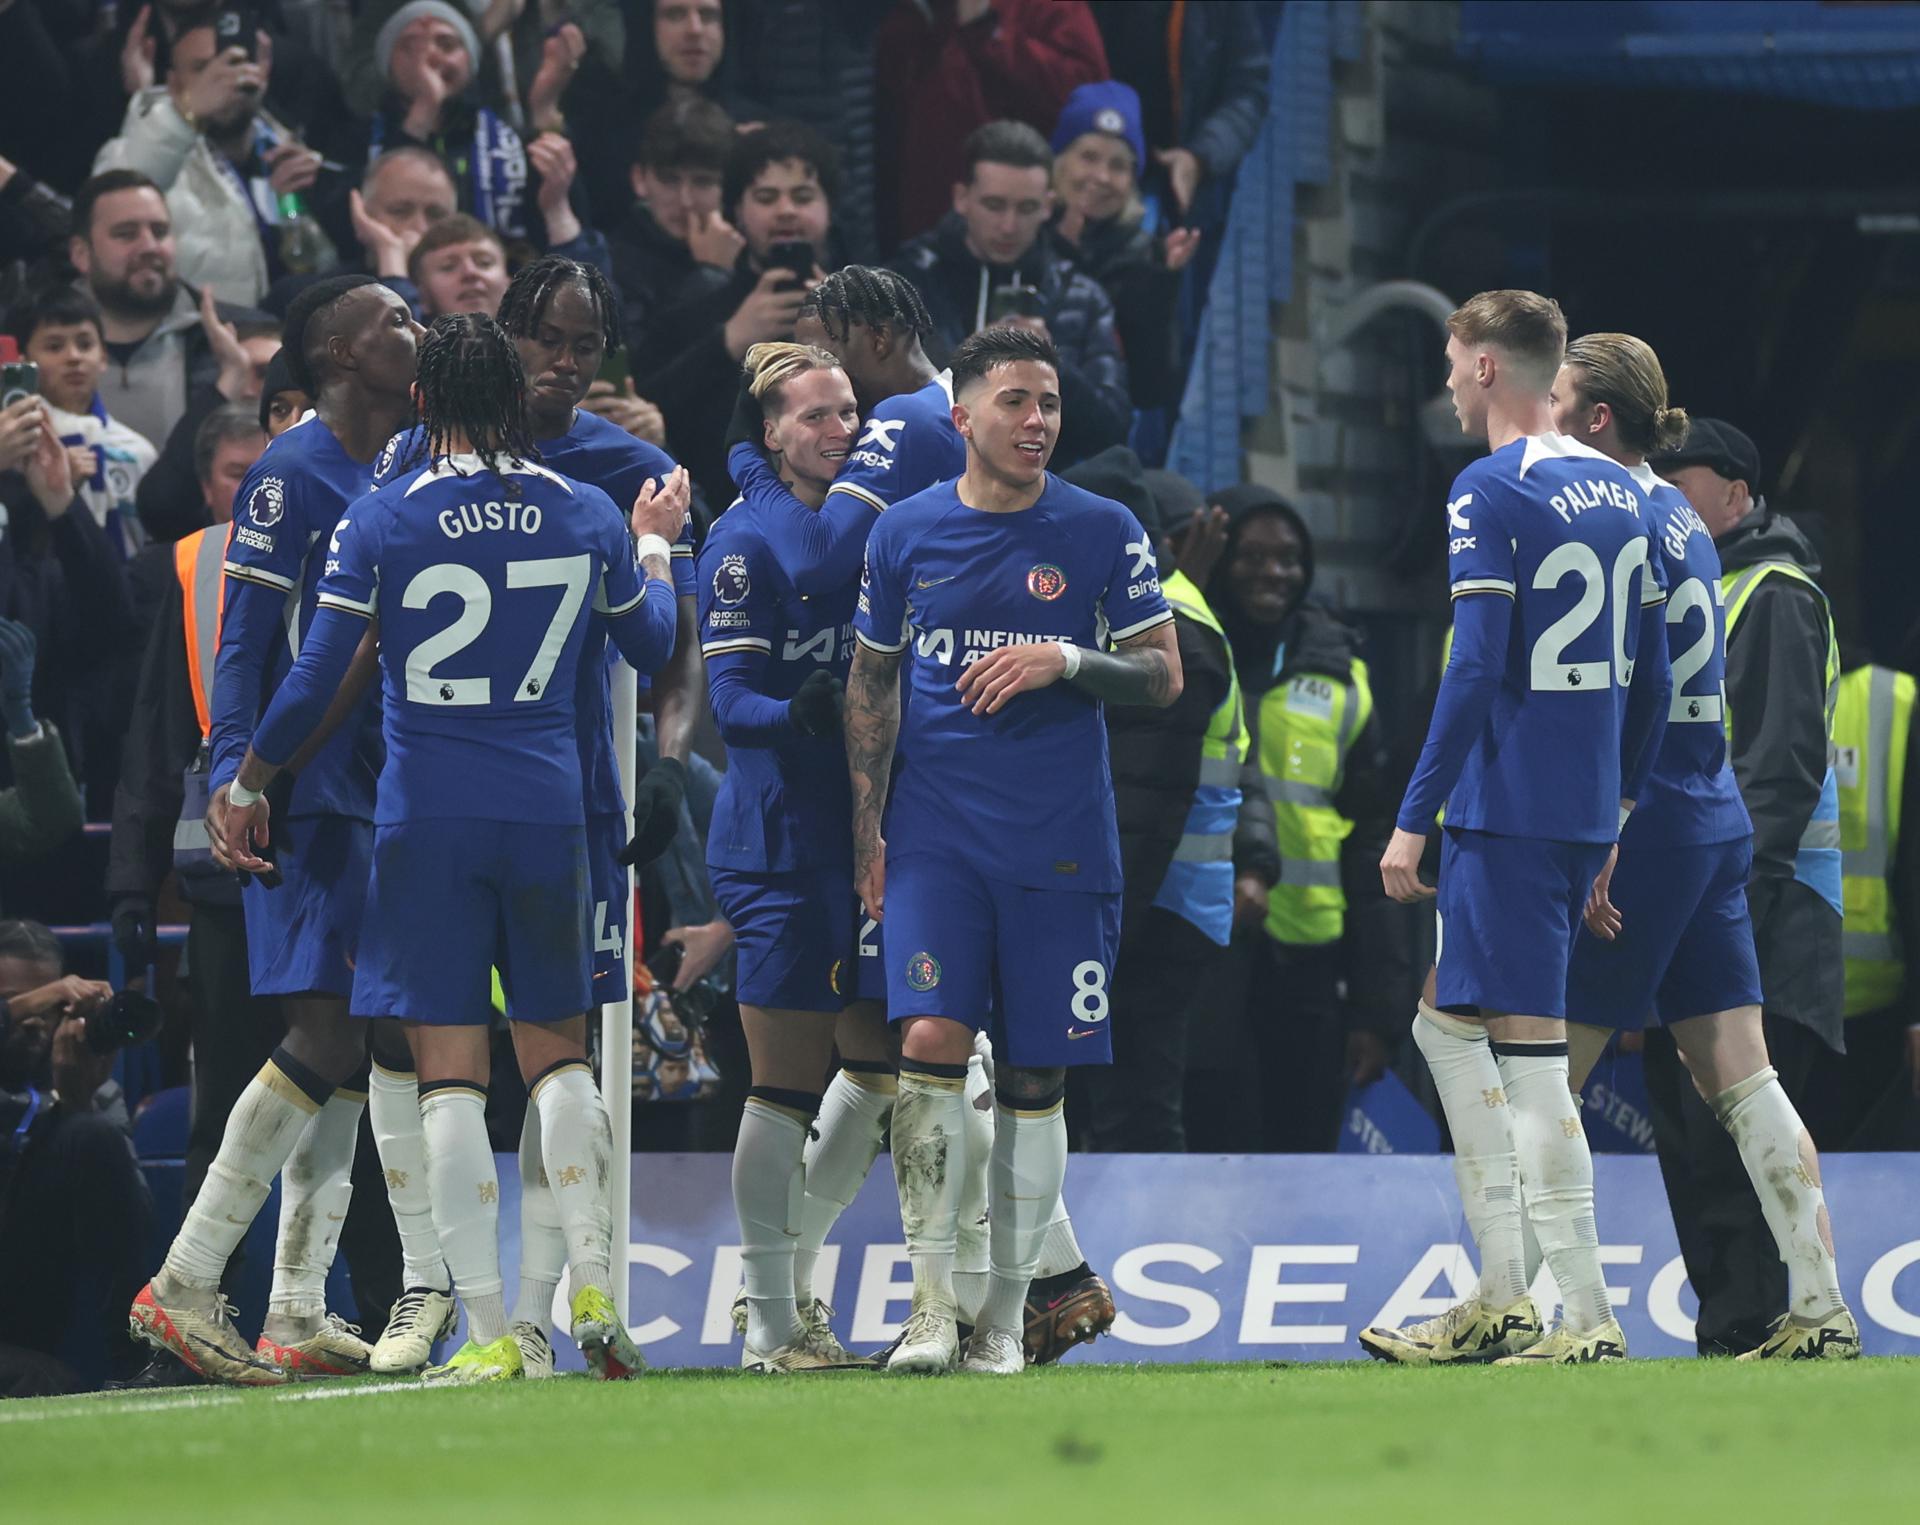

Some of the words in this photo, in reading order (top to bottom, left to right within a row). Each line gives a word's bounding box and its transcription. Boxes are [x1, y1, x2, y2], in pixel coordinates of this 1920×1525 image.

[438, 501, 543, 540] GUSTO
[1549, 479, 1640, 524] PALMER
[1127, 576, 1161, 600] Bing
[1530, 536, 1649, 691] 20
[402, 552, 591, 706] 27
[708, 619, 721, 628] for
[709, 609, 721, 619] No
[721, 611, 747, 620] room
[1664, 577, 1727, 723] 2
[593, 900, 623, 959] 4
[1070, 959, 1109, 1023] 8
